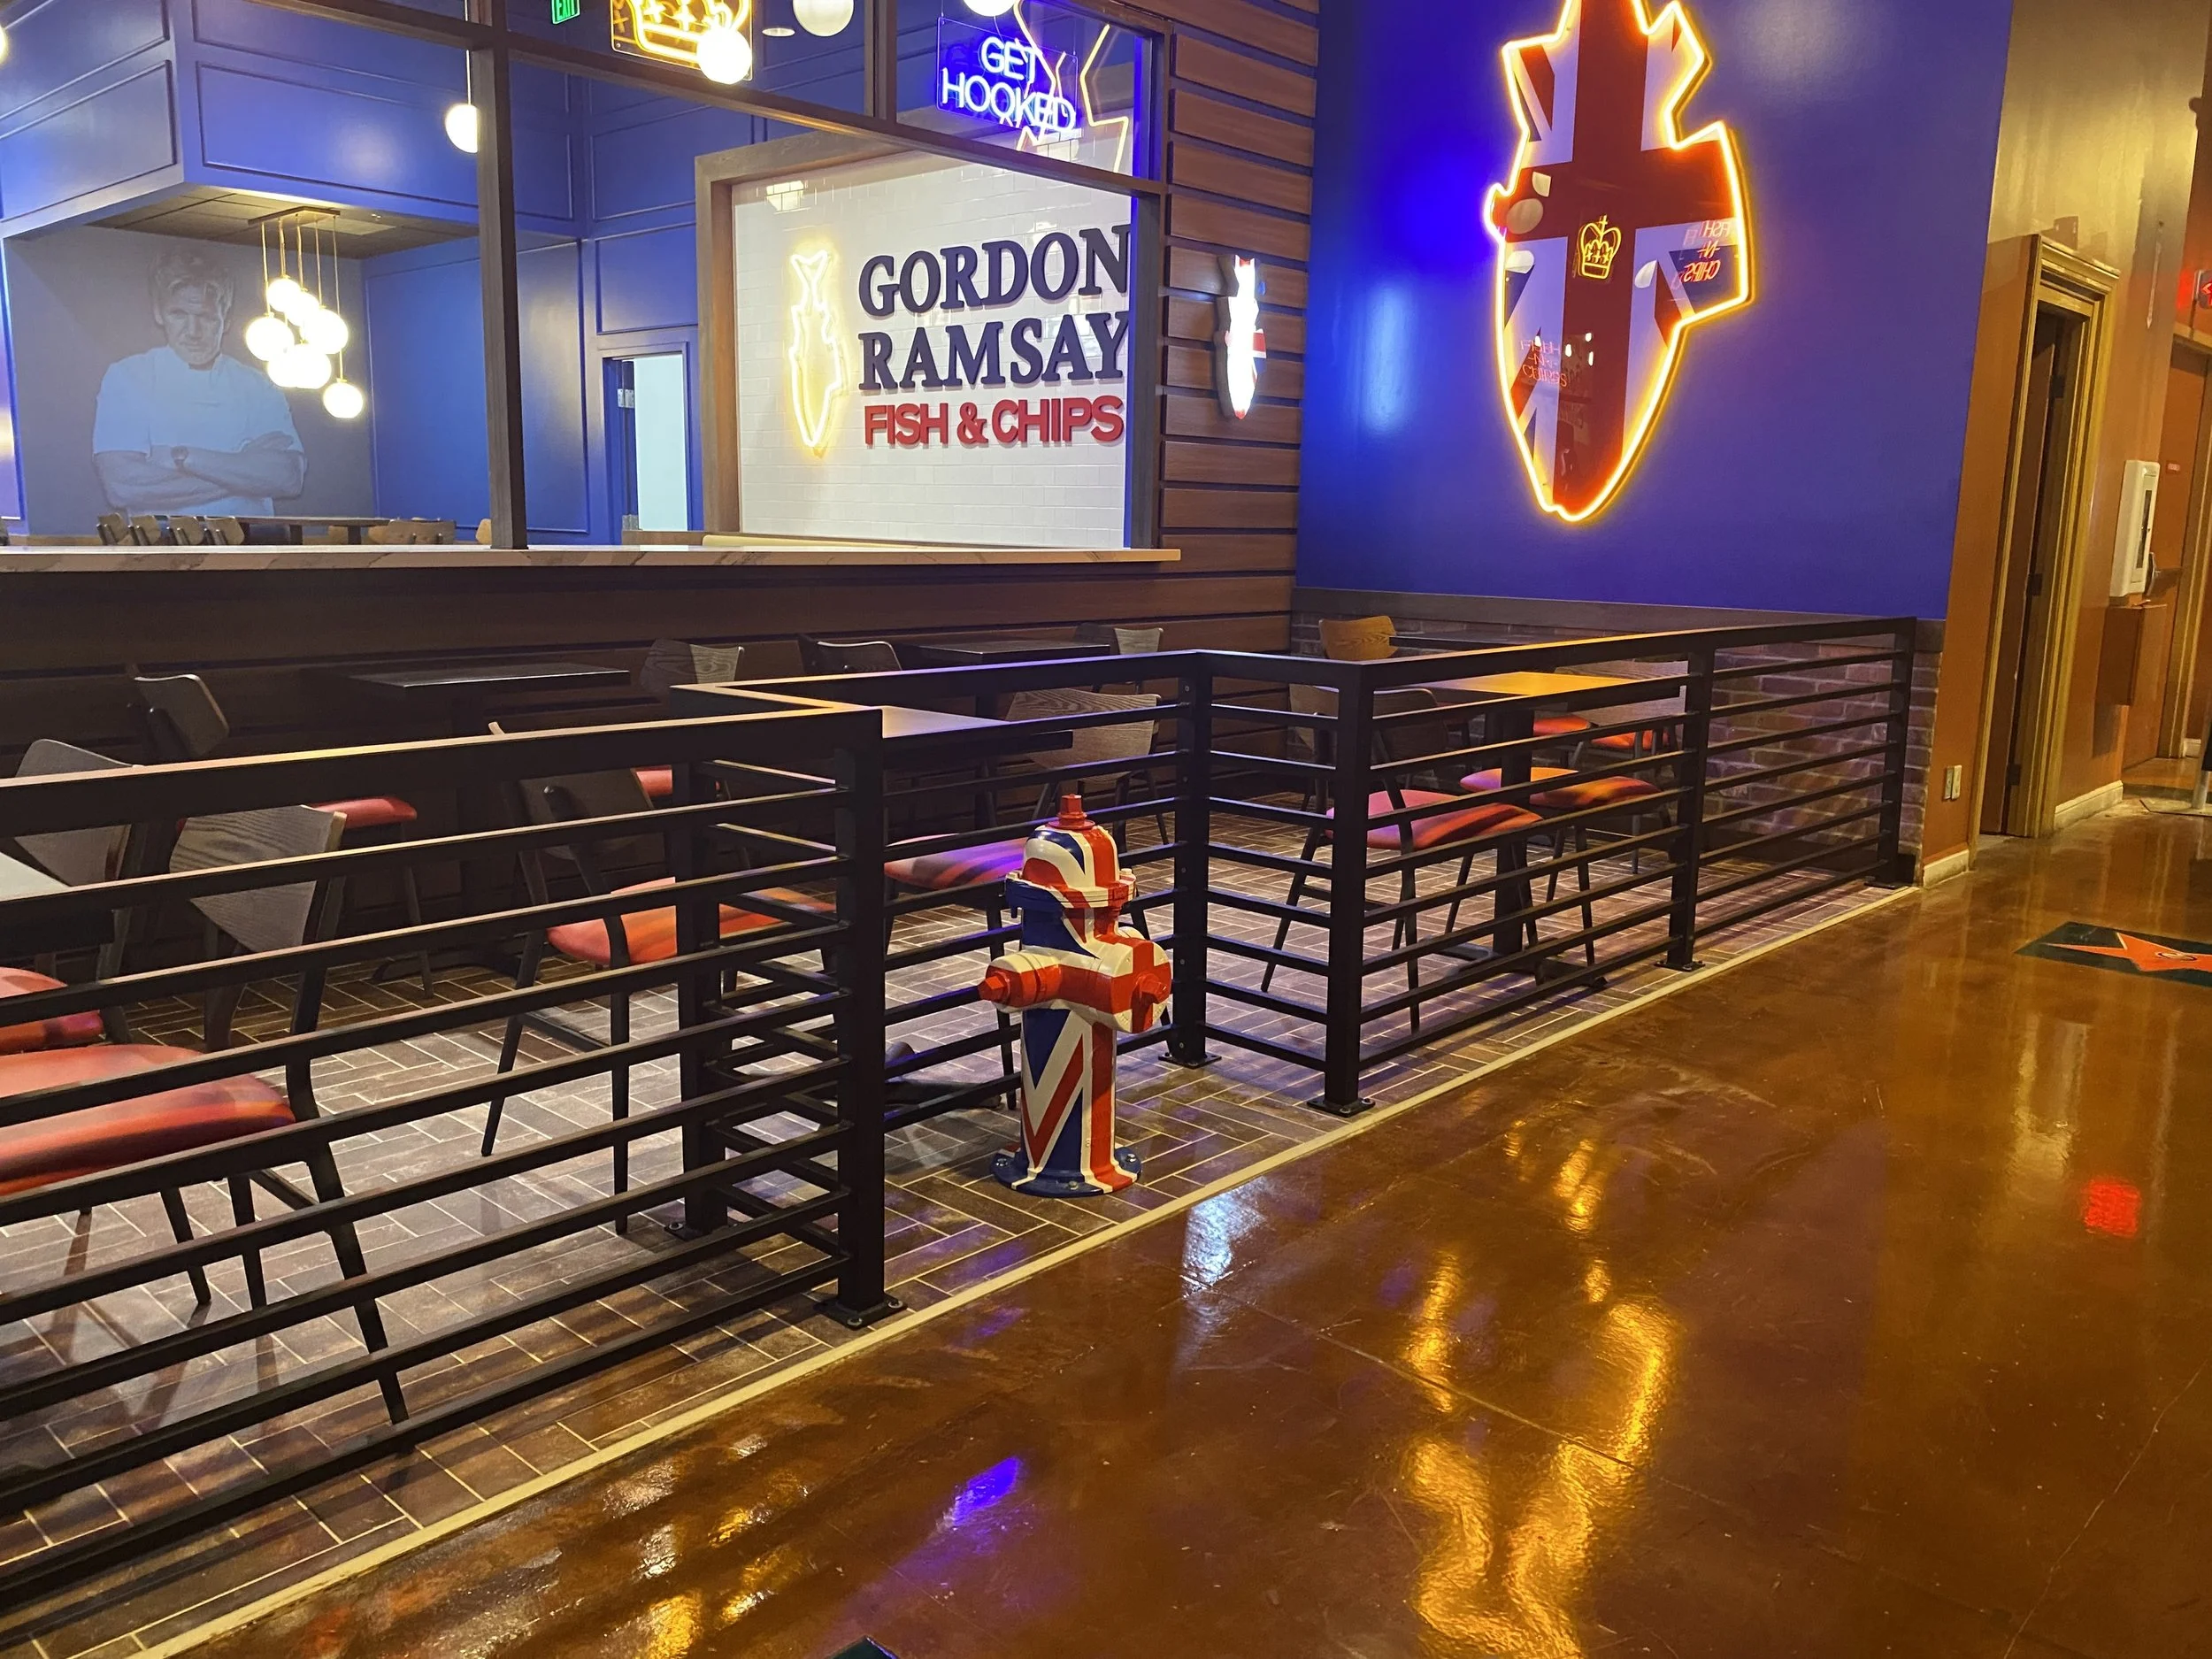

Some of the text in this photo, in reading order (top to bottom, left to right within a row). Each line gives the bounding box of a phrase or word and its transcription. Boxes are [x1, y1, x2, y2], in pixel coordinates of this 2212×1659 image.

[979, 36, 1038, 84] GET
[941, 67, 1077, 133] HOOKED
[858, 224, 1130, 317] GORDON
[858, 311, 1129, 390] RAMSAY
[864, 396, 1124, 445] FISH & CHIPS
